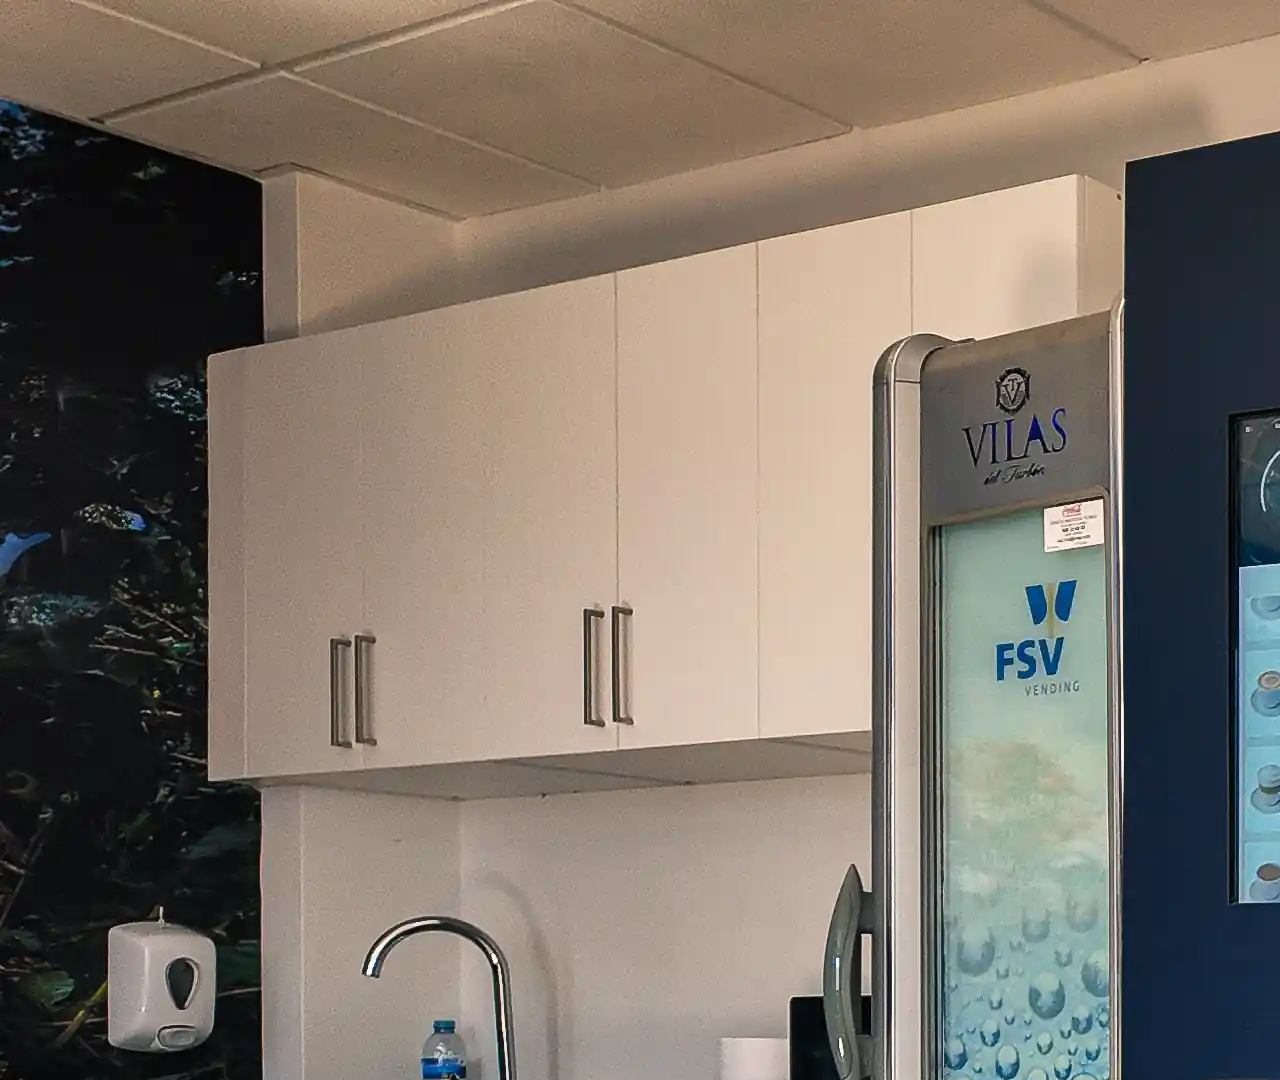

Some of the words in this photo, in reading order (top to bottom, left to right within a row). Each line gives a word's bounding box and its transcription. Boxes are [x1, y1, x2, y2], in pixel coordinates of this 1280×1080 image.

[963, 408, 1067, 467] VILAS
[996, 637, 1064, 681] FSV
[1025, 680, 1080, 696] VENDING
